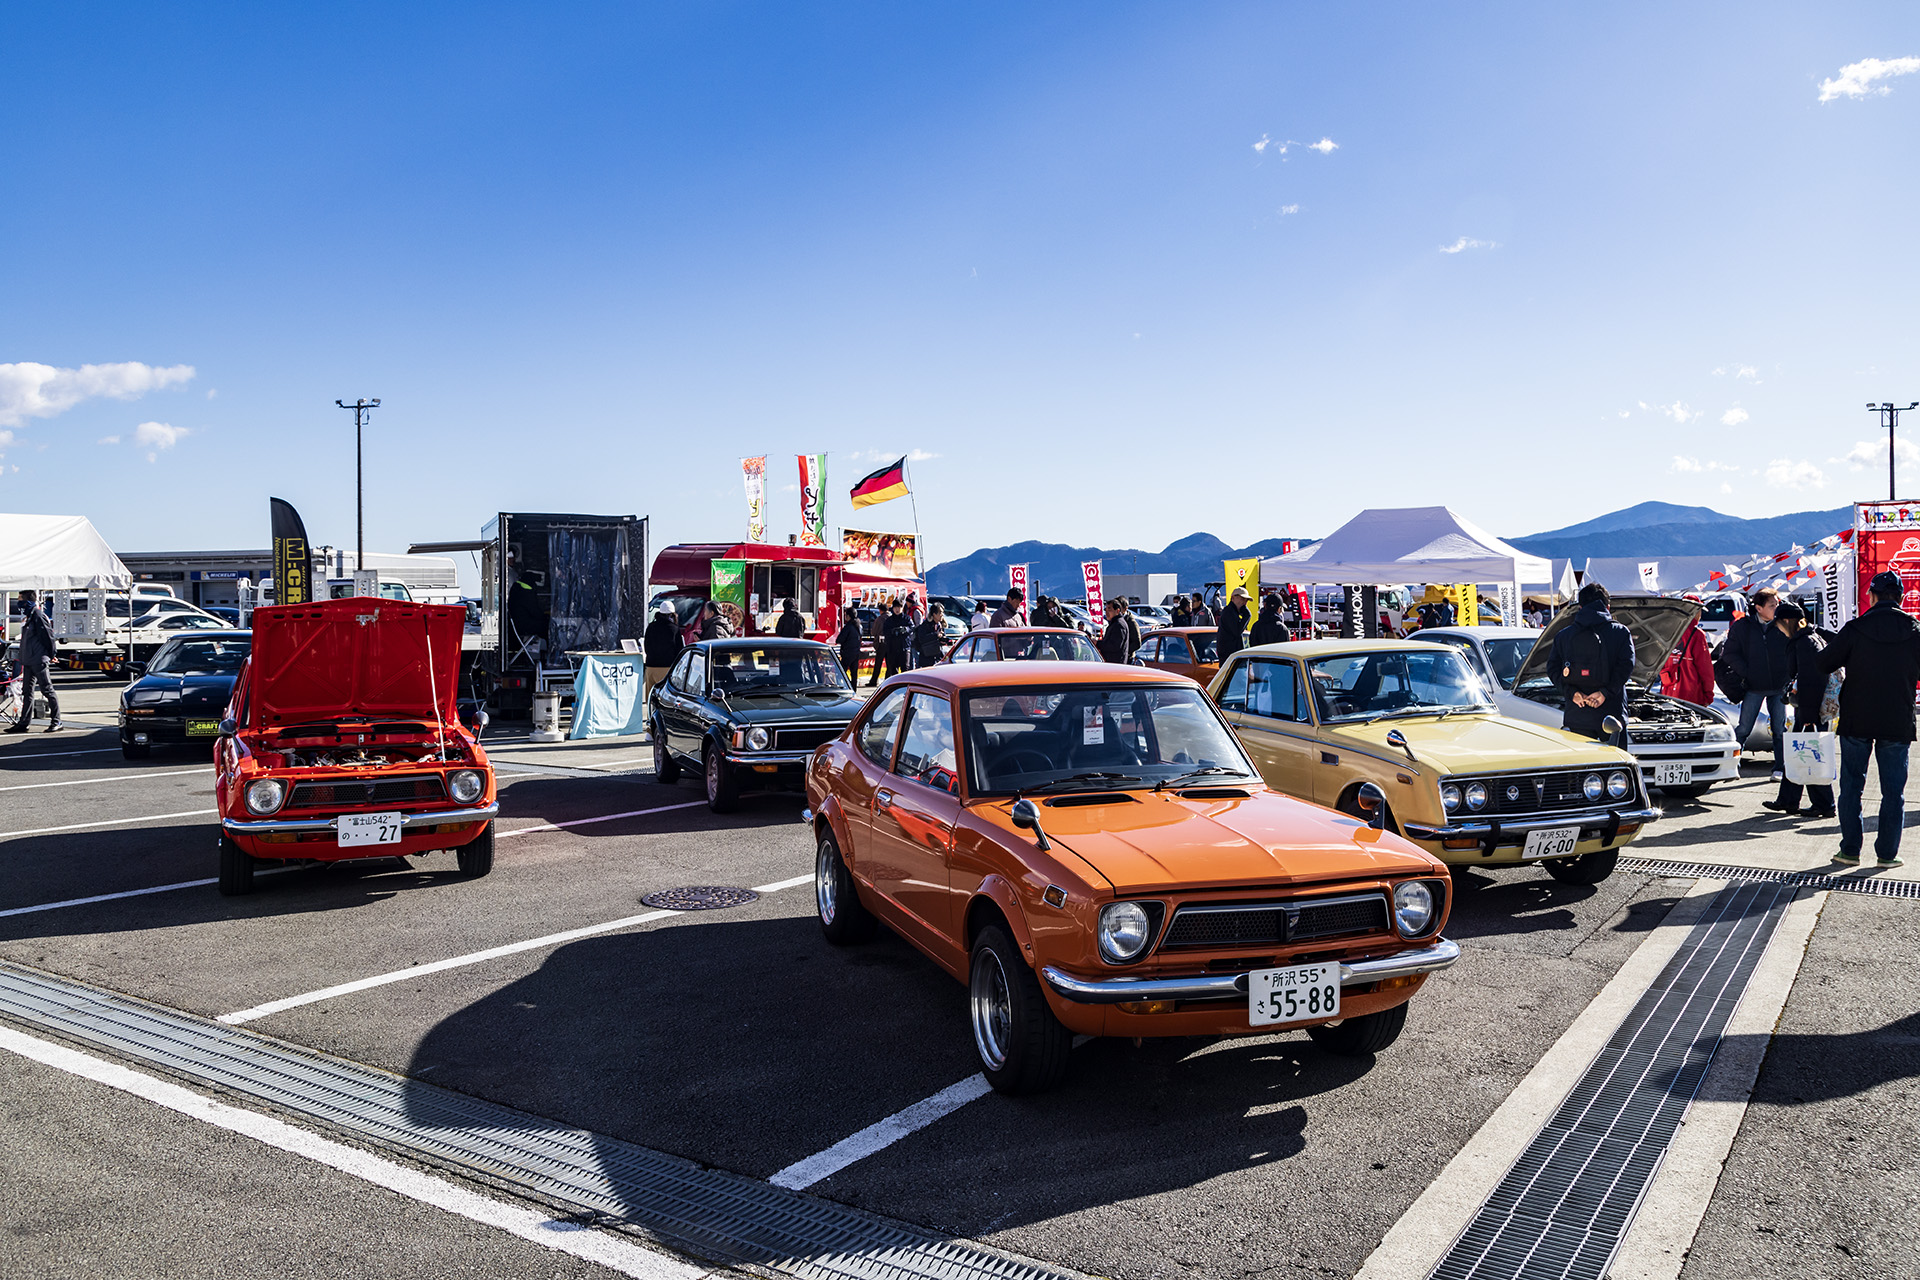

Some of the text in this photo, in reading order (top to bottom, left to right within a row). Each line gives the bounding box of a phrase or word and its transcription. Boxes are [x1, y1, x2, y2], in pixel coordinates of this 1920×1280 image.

[1863, 509, 1896, 524] INTER
[713, 569, 742, 584] Pizza
[718, 587, 735, 599] ピザ
[1664, 771, 1690, 784] 19-70
[341, 832, 351, 841] の
[1536, 838, 1574, 856] 16-00
[1299, 968, 1319, 984] 55
[1257, 985, 1335, 1019] さ 55-88
